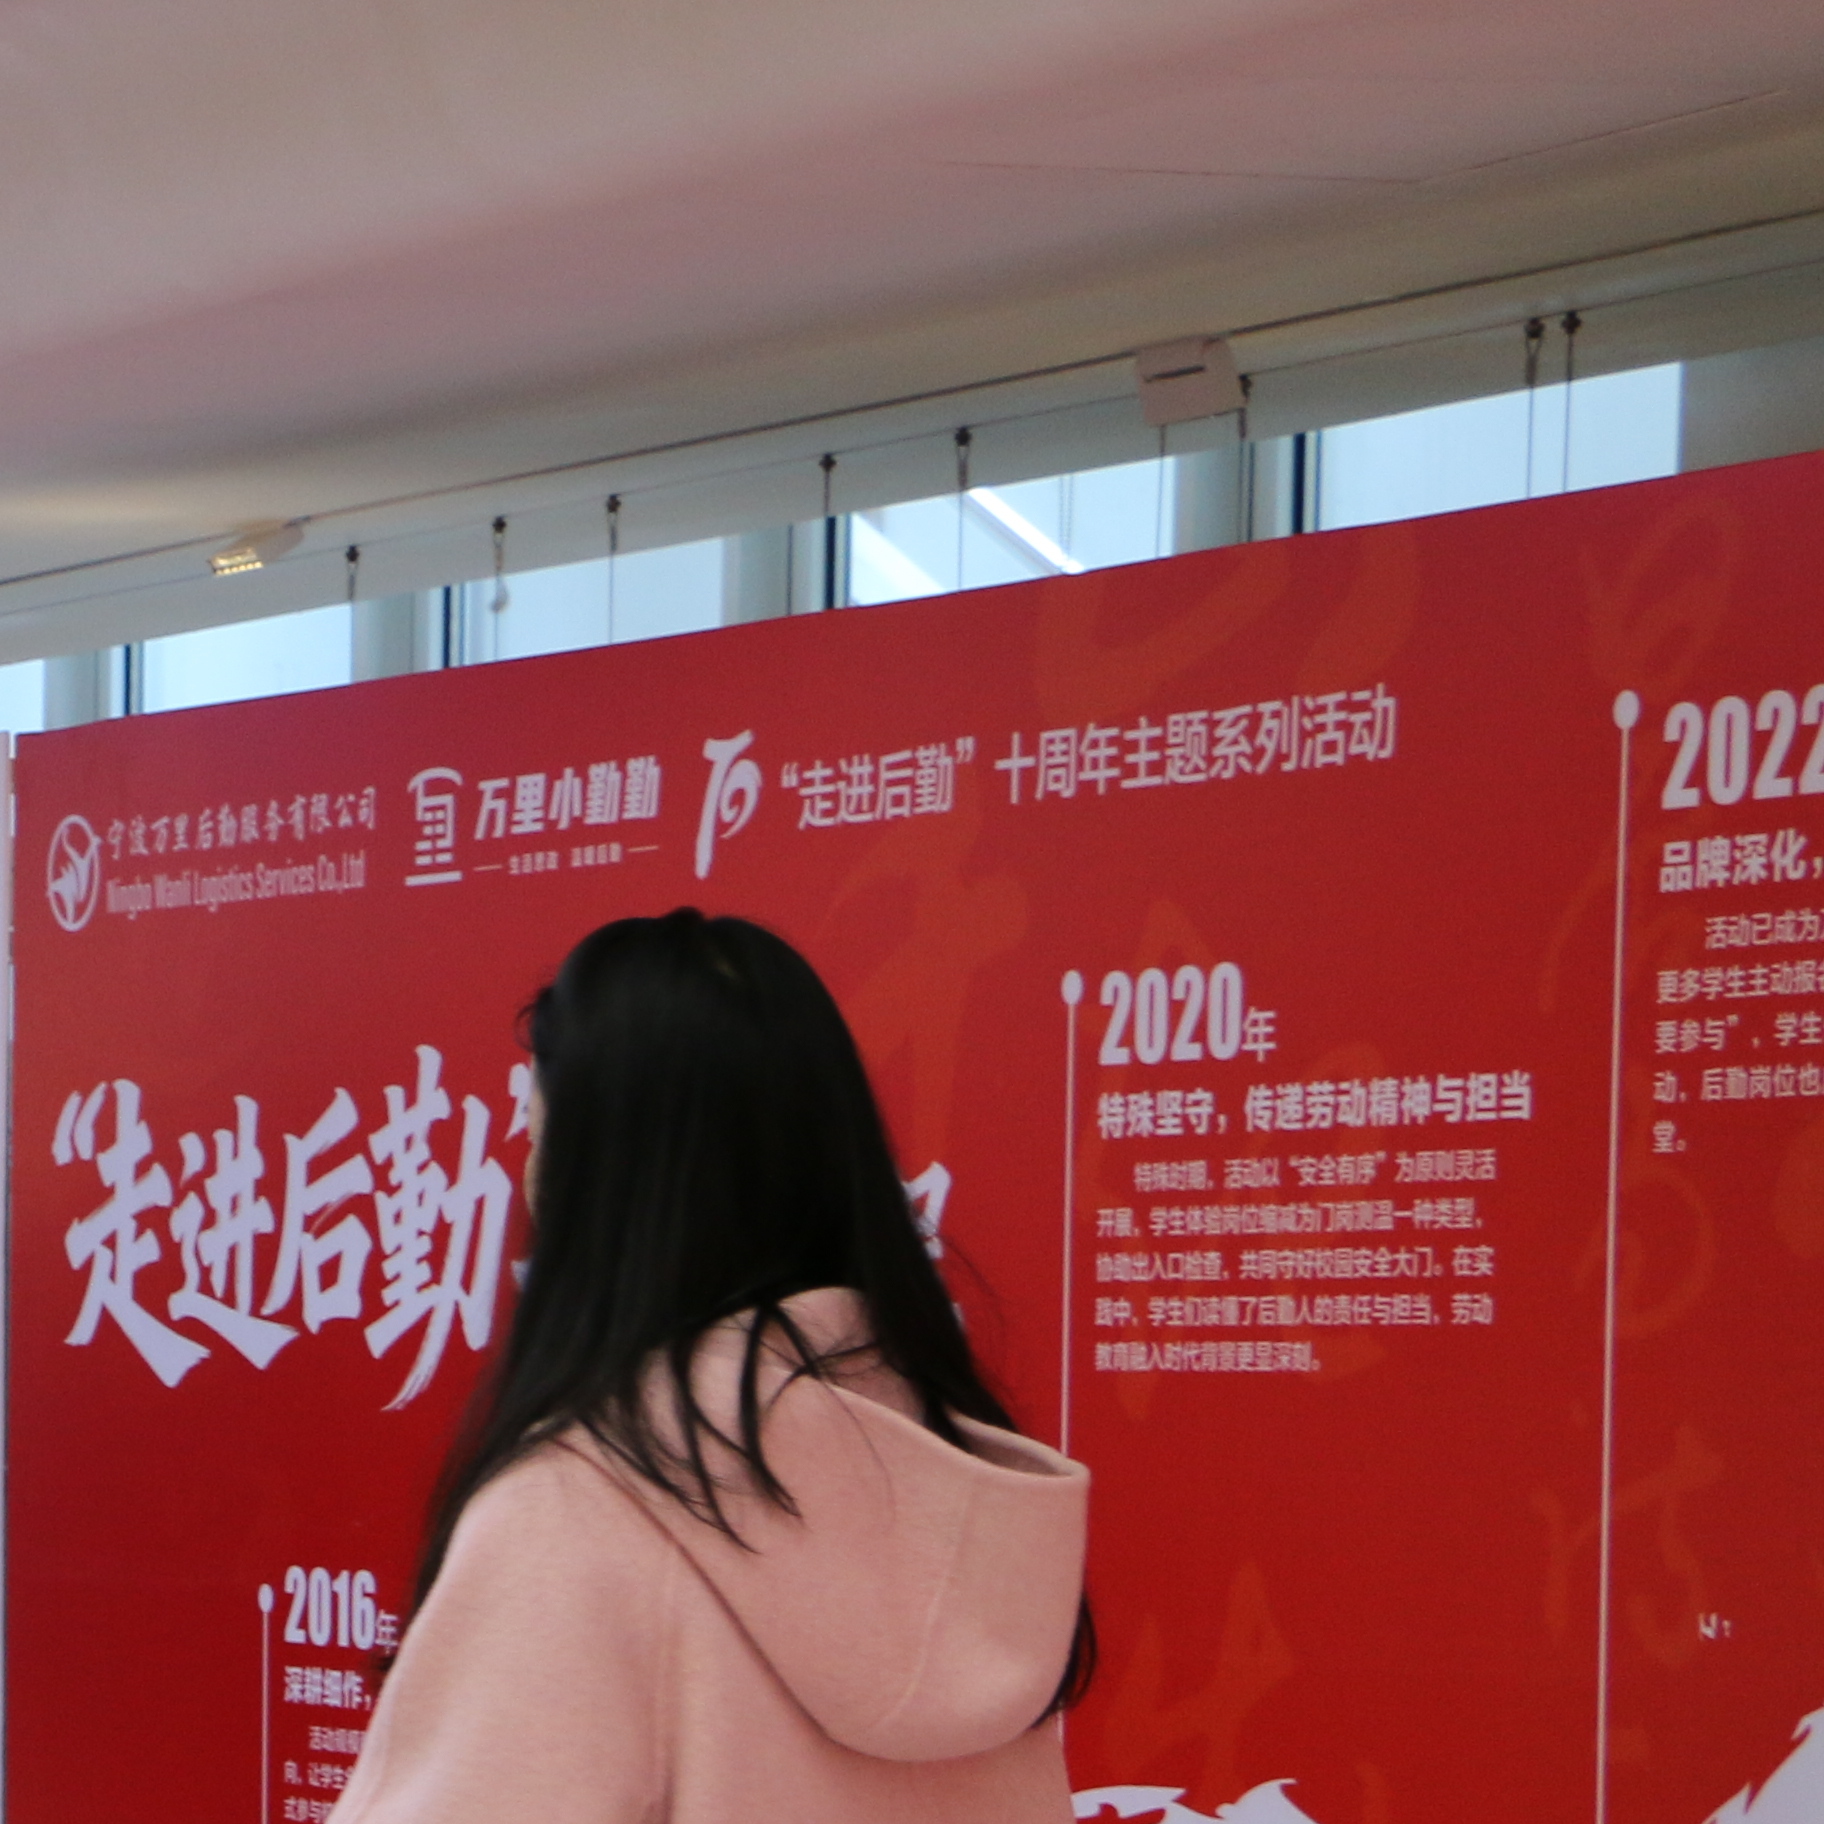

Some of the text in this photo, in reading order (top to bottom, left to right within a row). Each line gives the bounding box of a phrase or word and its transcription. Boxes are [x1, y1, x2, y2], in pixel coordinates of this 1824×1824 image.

[1661, 683, 1824, 810] 2022
[106, 786, 376, 860] 宁波万里后勤服务有限公司
[474, 754, 662, 841] 万里小勤勤
[194, 864, 253, 913] Logistics
[256, 857, 315, 899] Services
[1660, 828, 1824, 893] 品牌深化，
[1705, 908, 1824, 951] 活动已成为
[1098, 961, 1277, 1066] 2020年
[1097, 1069, 1533, 1140] 特殊坚守，传递劳动精神与担当
[1653, 1062, 1824, 1103] 动，后勤岗位也
[284, 1565, 399, 1654] 2016年
